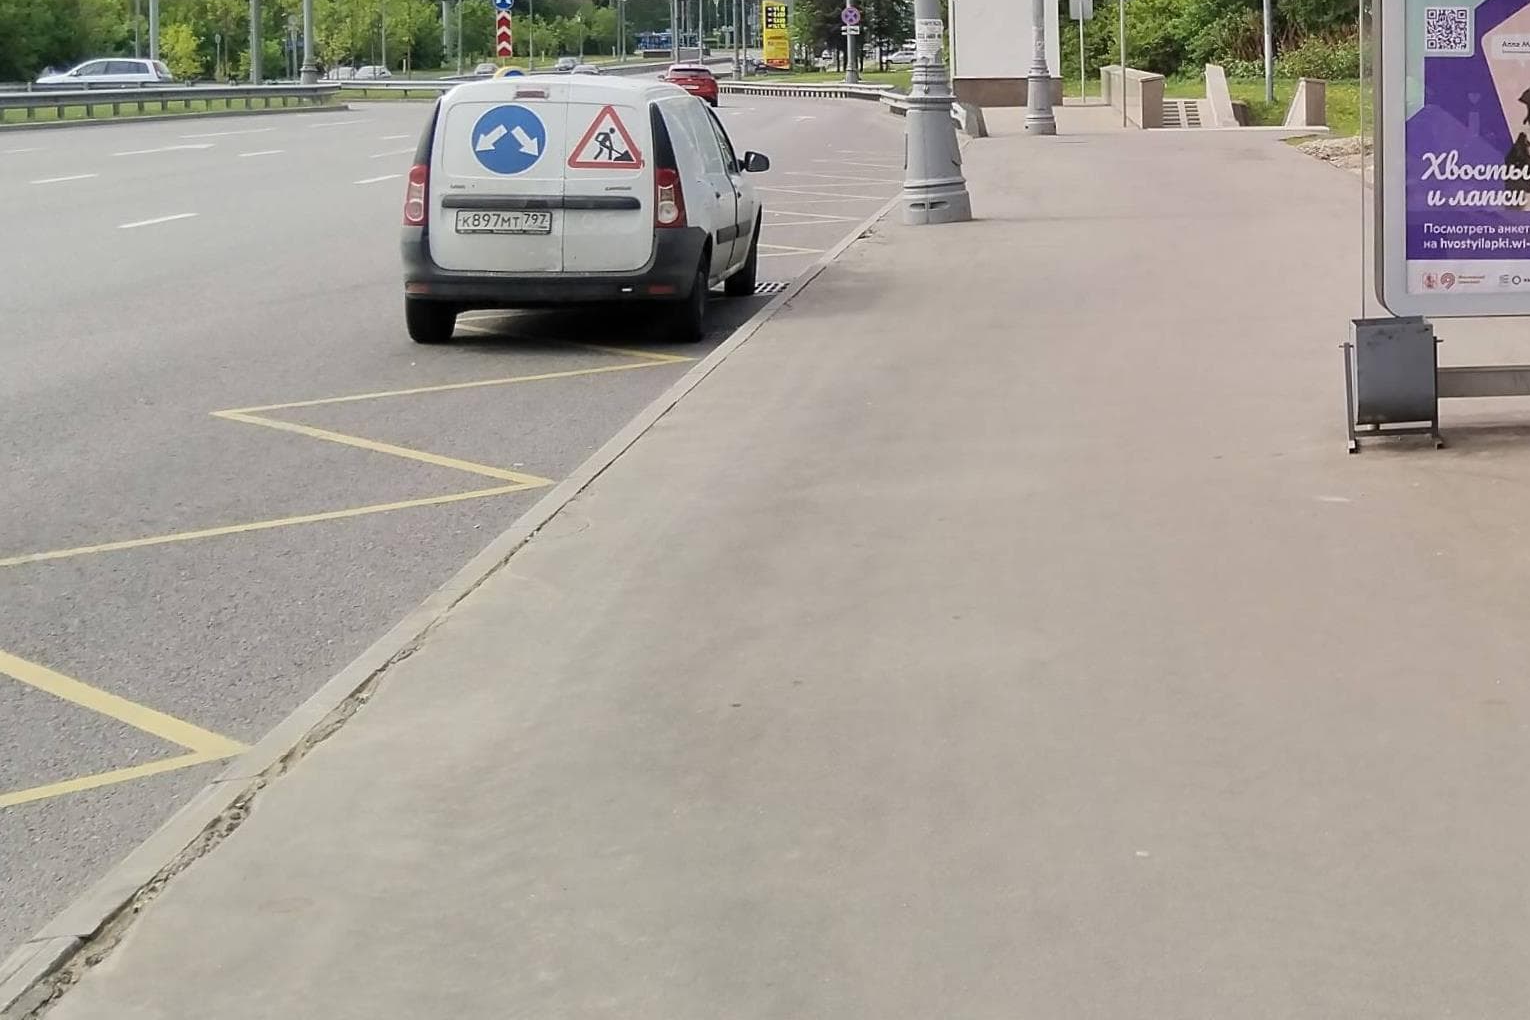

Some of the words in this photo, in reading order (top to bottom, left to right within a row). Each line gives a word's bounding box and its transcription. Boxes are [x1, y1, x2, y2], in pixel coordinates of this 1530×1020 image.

[1427, 189, 1446, 206] и
[1448, 189, 1529, 207] лапки
[461, 213, 521, 227] К897МТ
[523, 212, 546, 225] 797
[1423, 222, 1496, 235] Посмотреть
[1423, 240, 1438, 249] на
